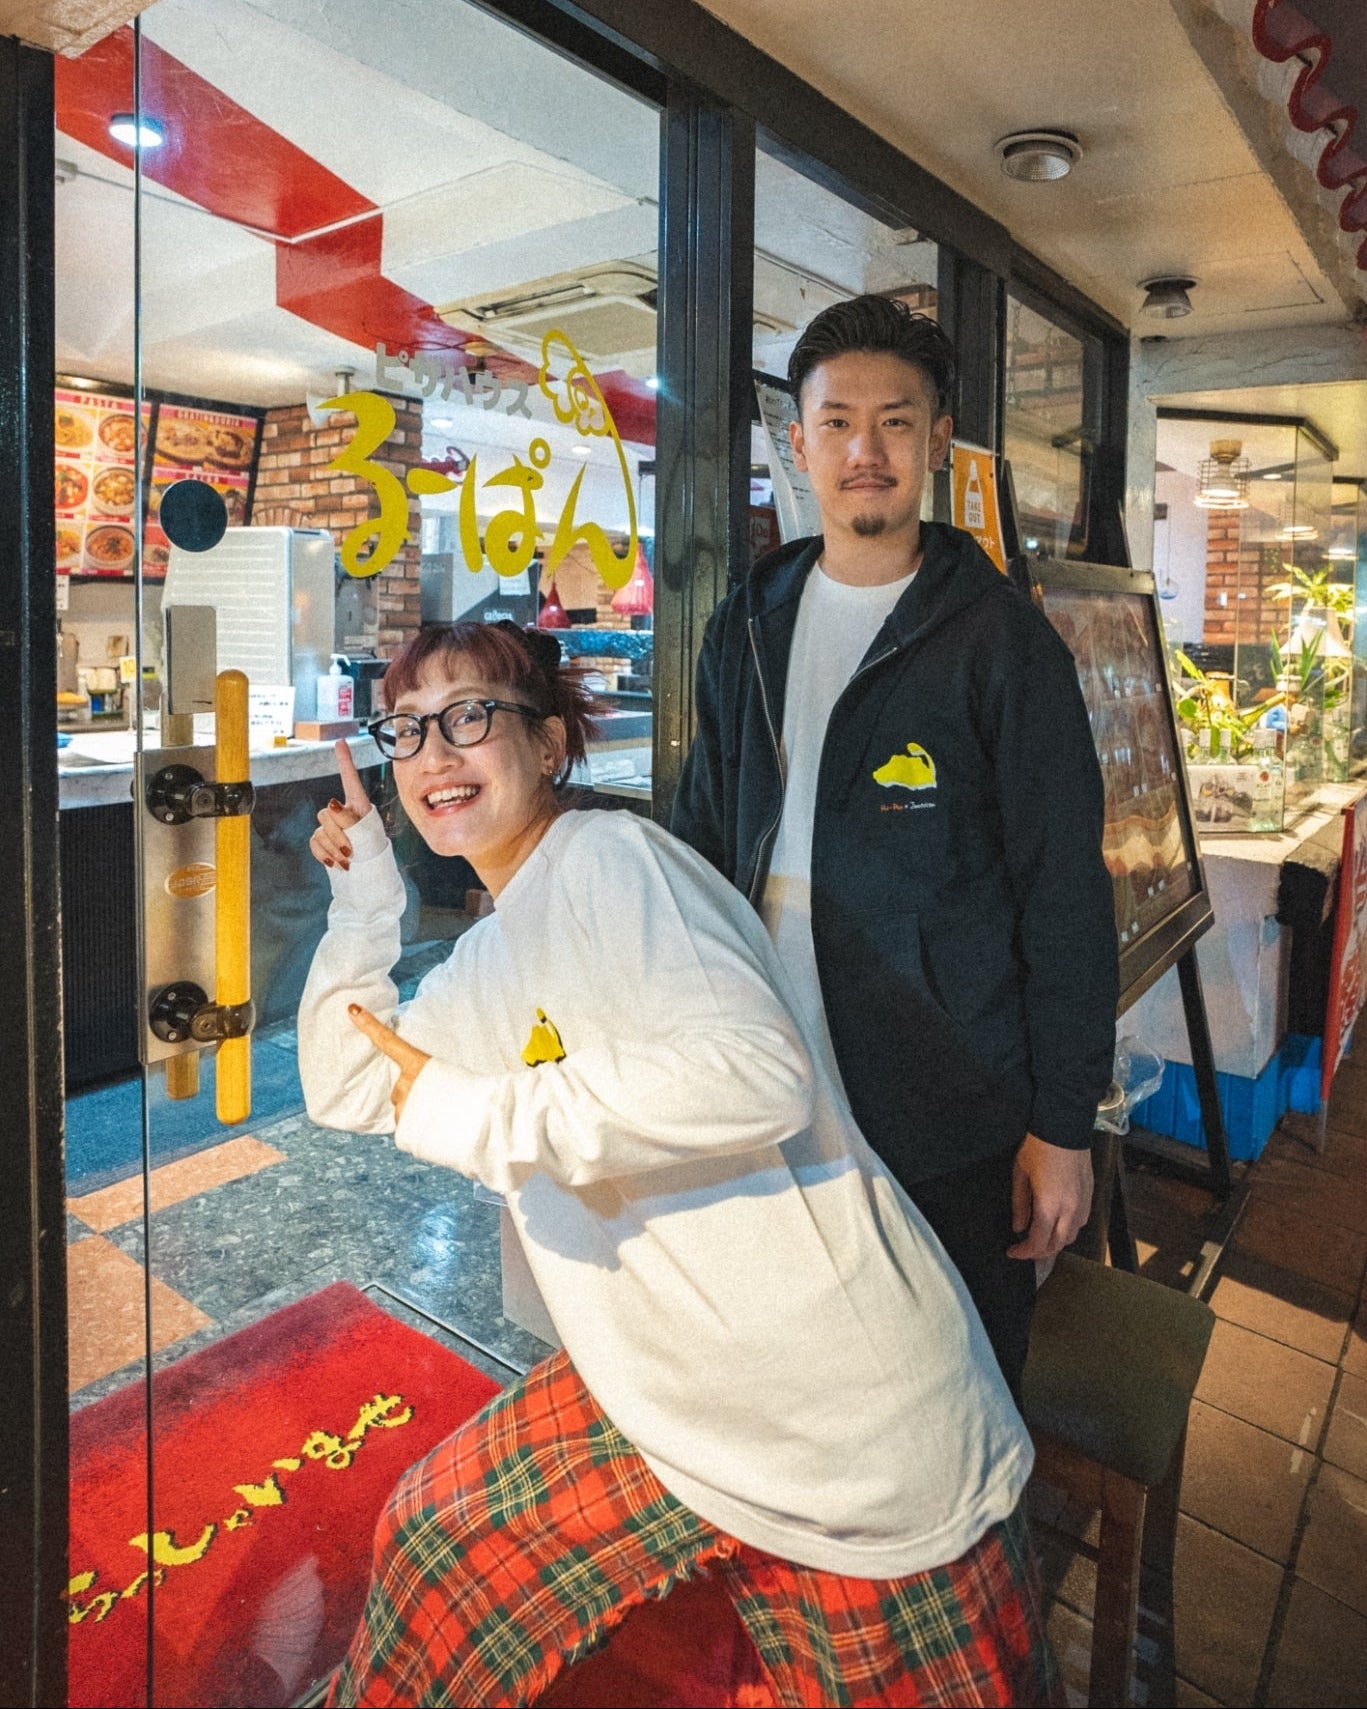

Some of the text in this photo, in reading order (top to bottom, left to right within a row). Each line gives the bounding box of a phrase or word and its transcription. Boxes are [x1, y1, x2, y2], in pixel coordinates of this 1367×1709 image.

[315, 390, 638, 590] るーぱん
[967, 500, 981, 512] TAKE
[968, 512, 981, 523] OUT
